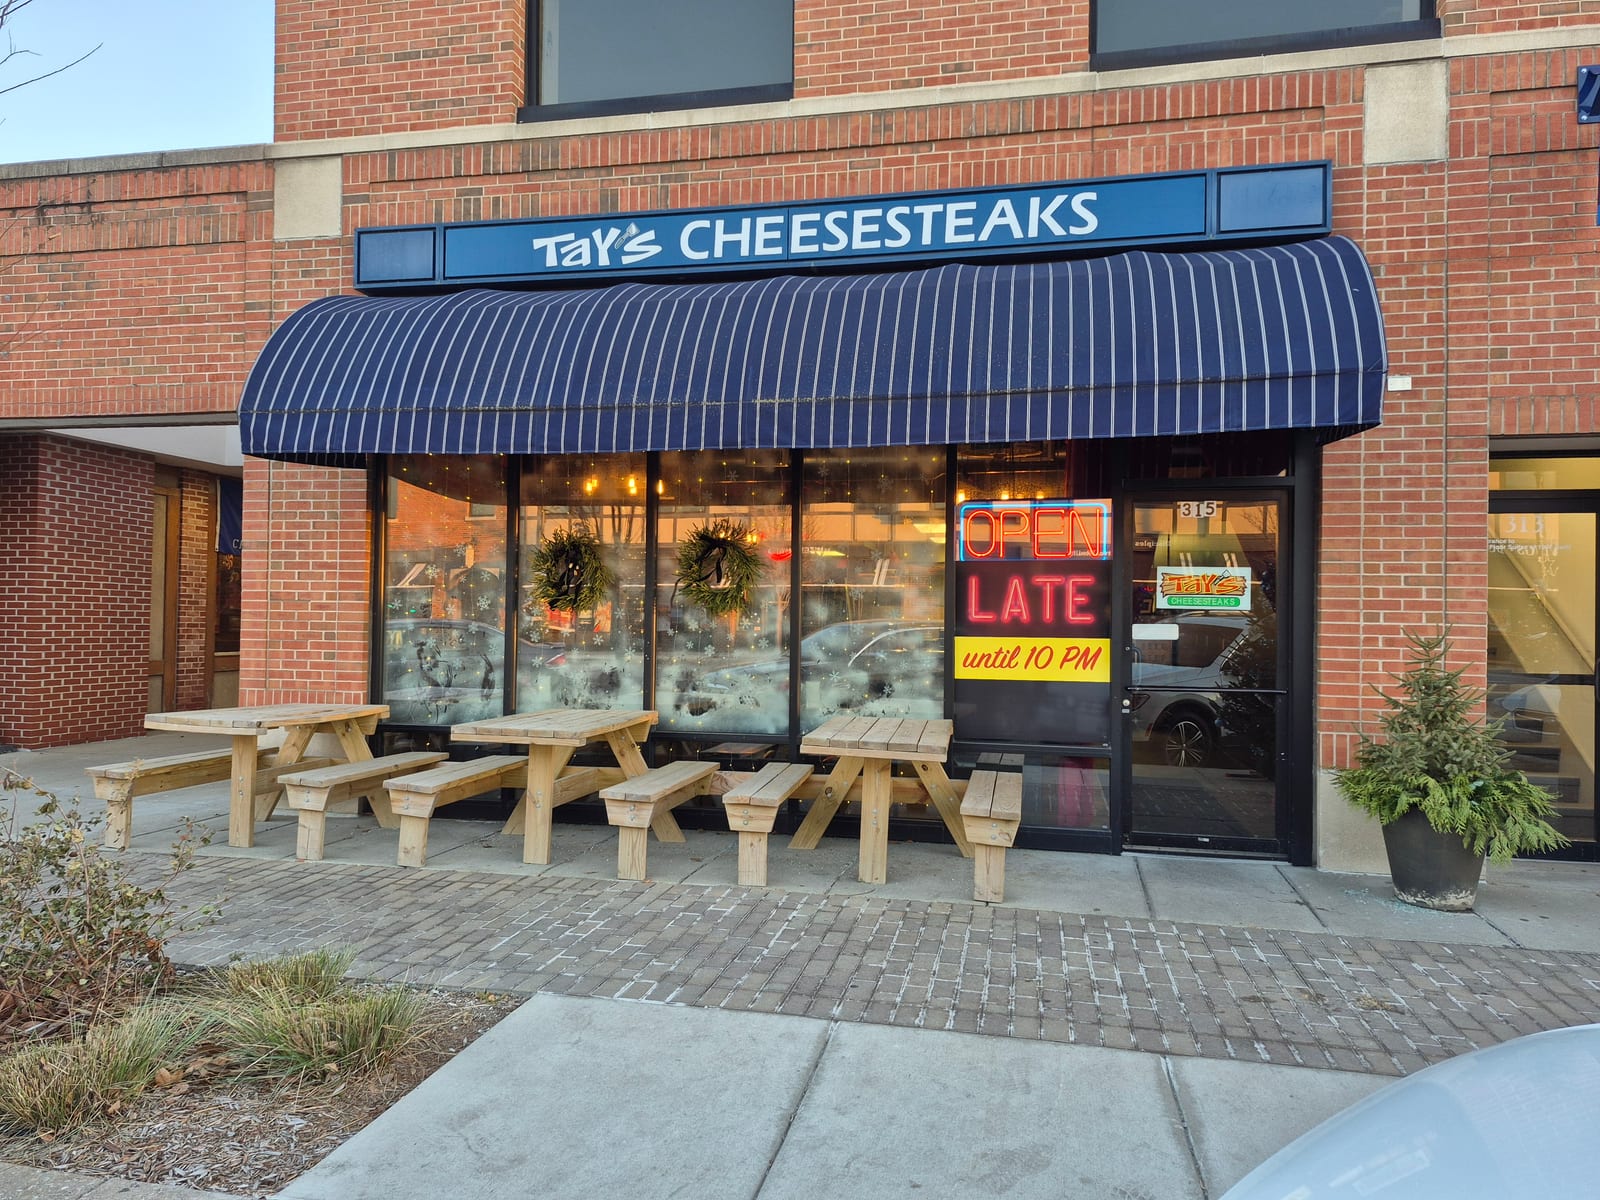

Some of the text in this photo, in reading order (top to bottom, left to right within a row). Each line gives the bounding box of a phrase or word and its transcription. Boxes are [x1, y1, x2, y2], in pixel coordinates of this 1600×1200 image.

[680, 191, 1098, 260] CHEESESTEAKS
[1182, 501, 1215, 517] 315
[964, 508, 1101, 559] OPEN
[967, 575, 1095, 624] LATE
[1170, 597, 1236, 606] CHEESESTEAKS
[962, 645, 1103, 671] until 10 PM
